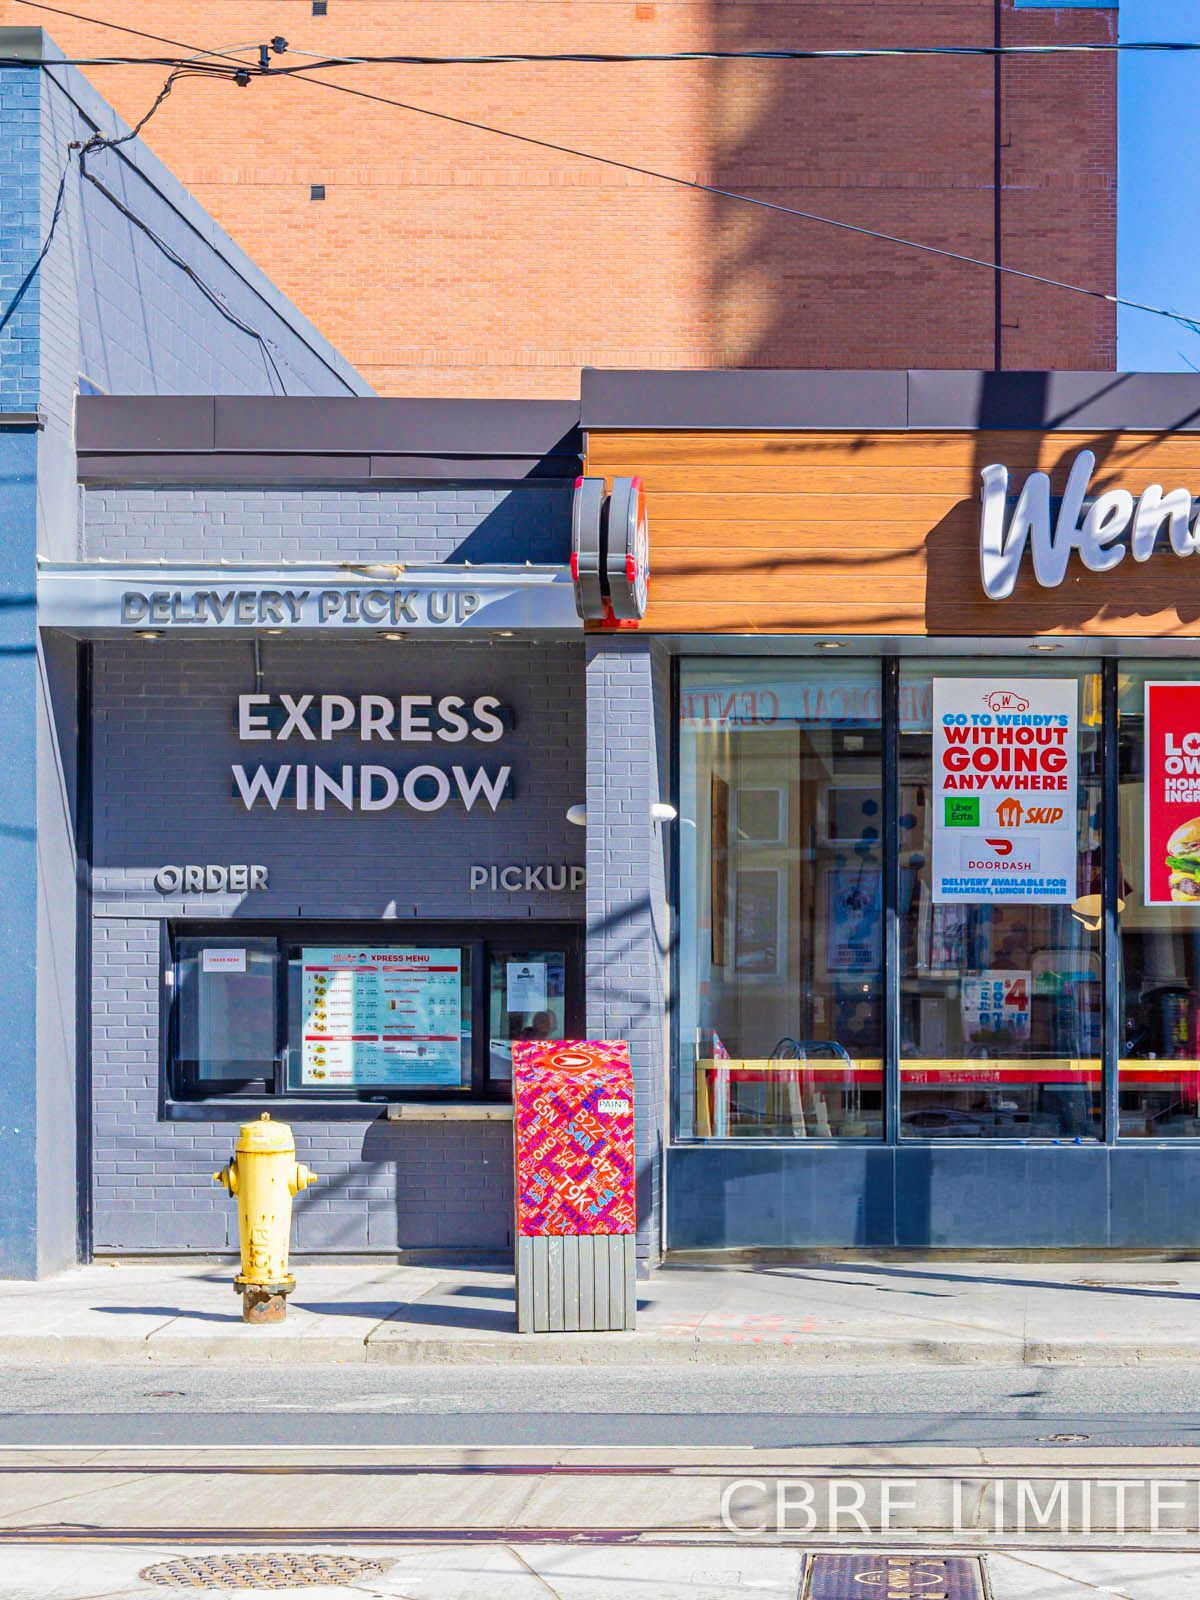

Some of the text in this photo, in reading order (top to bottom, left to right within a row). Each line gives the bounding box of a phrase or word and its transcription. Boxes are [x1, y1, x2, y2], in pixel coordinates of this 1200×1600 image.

[122, 590, 481, 623] DELIVERY PICK UP
[239, 694, 504, 742] EXPRESS
[943, 714, 1068, 726] GO TO WENDY'S
[943, 727, 1068, 745] WITHOUT
[943, 747, 1068, 772] GOING
[232, 765, 511, 812] WINDOW
[943, 775, 1067, 790] ANYWHERE
[951, 803, 973, 811] Uber
[951, 812, 973, 820] Eats
[1024, 808, 1063, 824] SKIP
[968, 862, 1031, 870] DOORDASH
[156, 865, 269, 893] ORDER
[470, 866, 586, 891] PICKUP
[942, 878, 1067, 887] DELIVERY AVAILABLE FOR
[599, 1101, 628, 1109] PAIN?
[574, 1109, 607, 1140] B2Z
[564, 1120, 596, 1151] S4N
[554, 1174, 594, 1213] T9K
